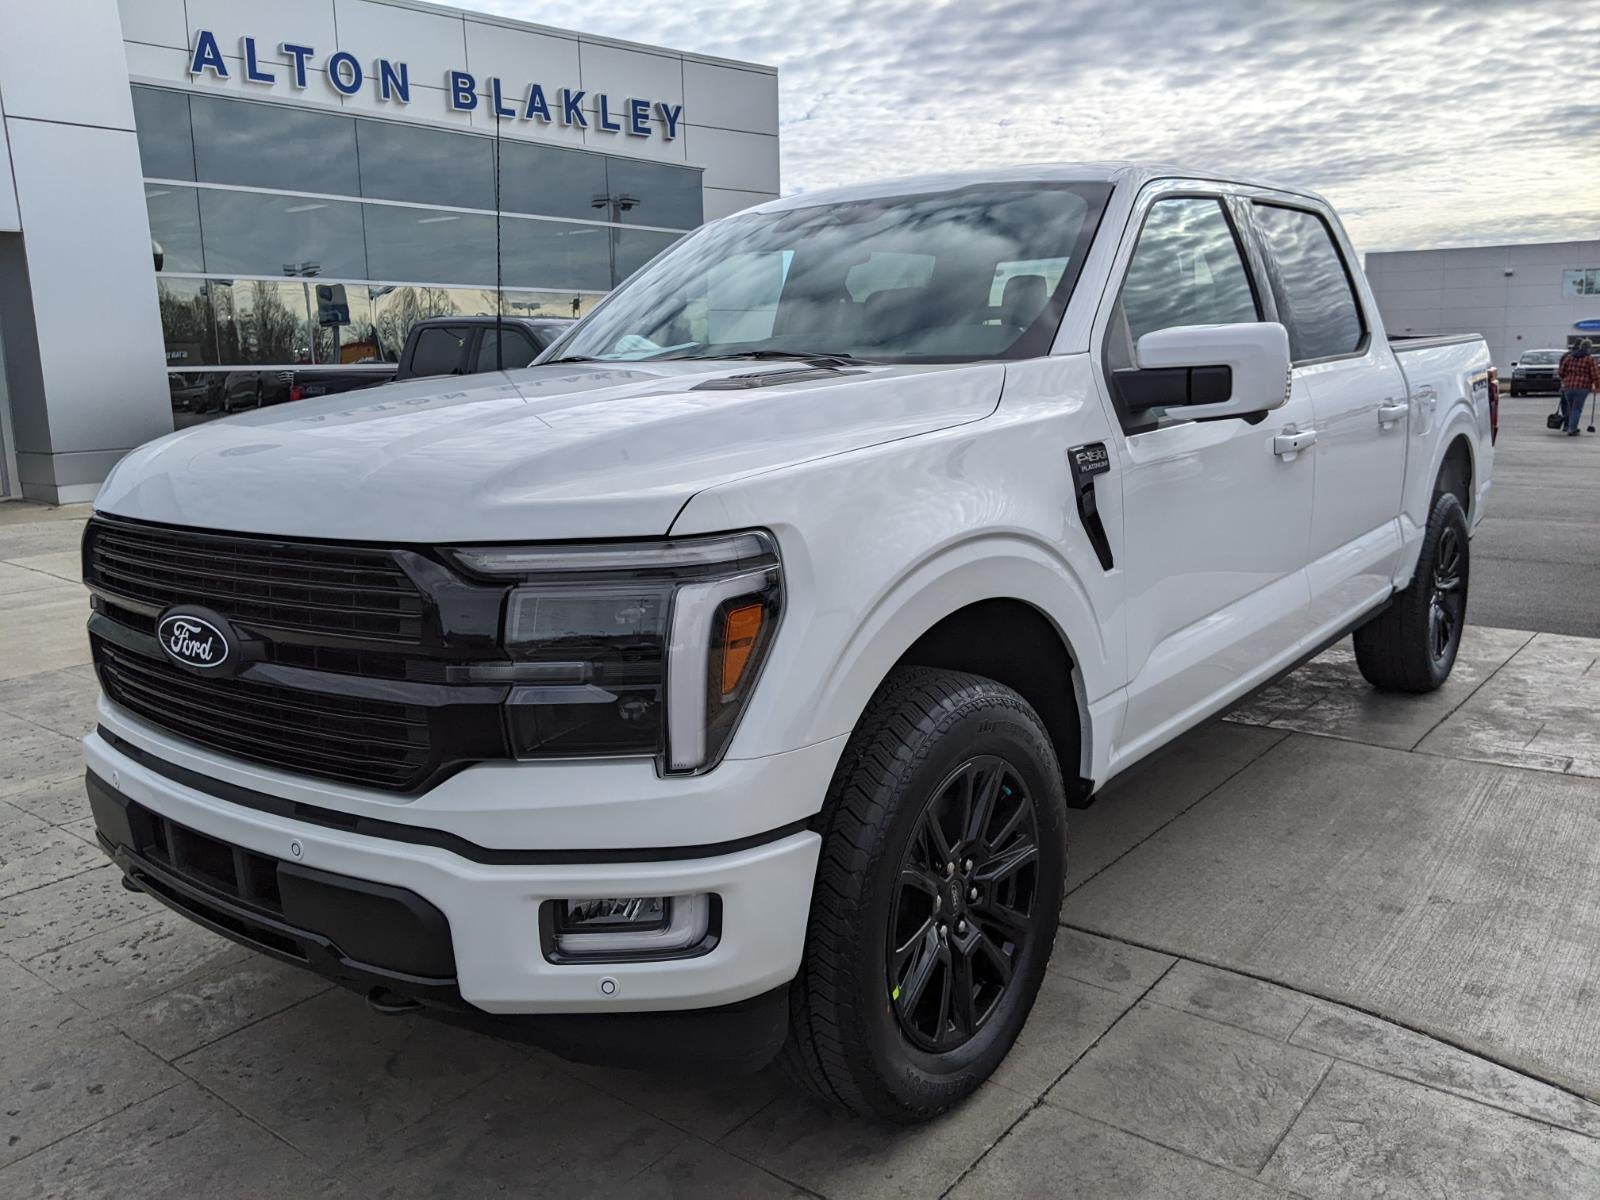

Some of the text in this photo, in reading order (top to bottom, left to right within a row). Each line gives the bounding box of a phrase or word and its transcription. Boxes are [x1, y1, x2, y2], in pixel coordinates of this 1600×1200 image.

[190, 29, 684, 140] ALTON BLAKLEY
[170, 621, 214, 661] Ford
